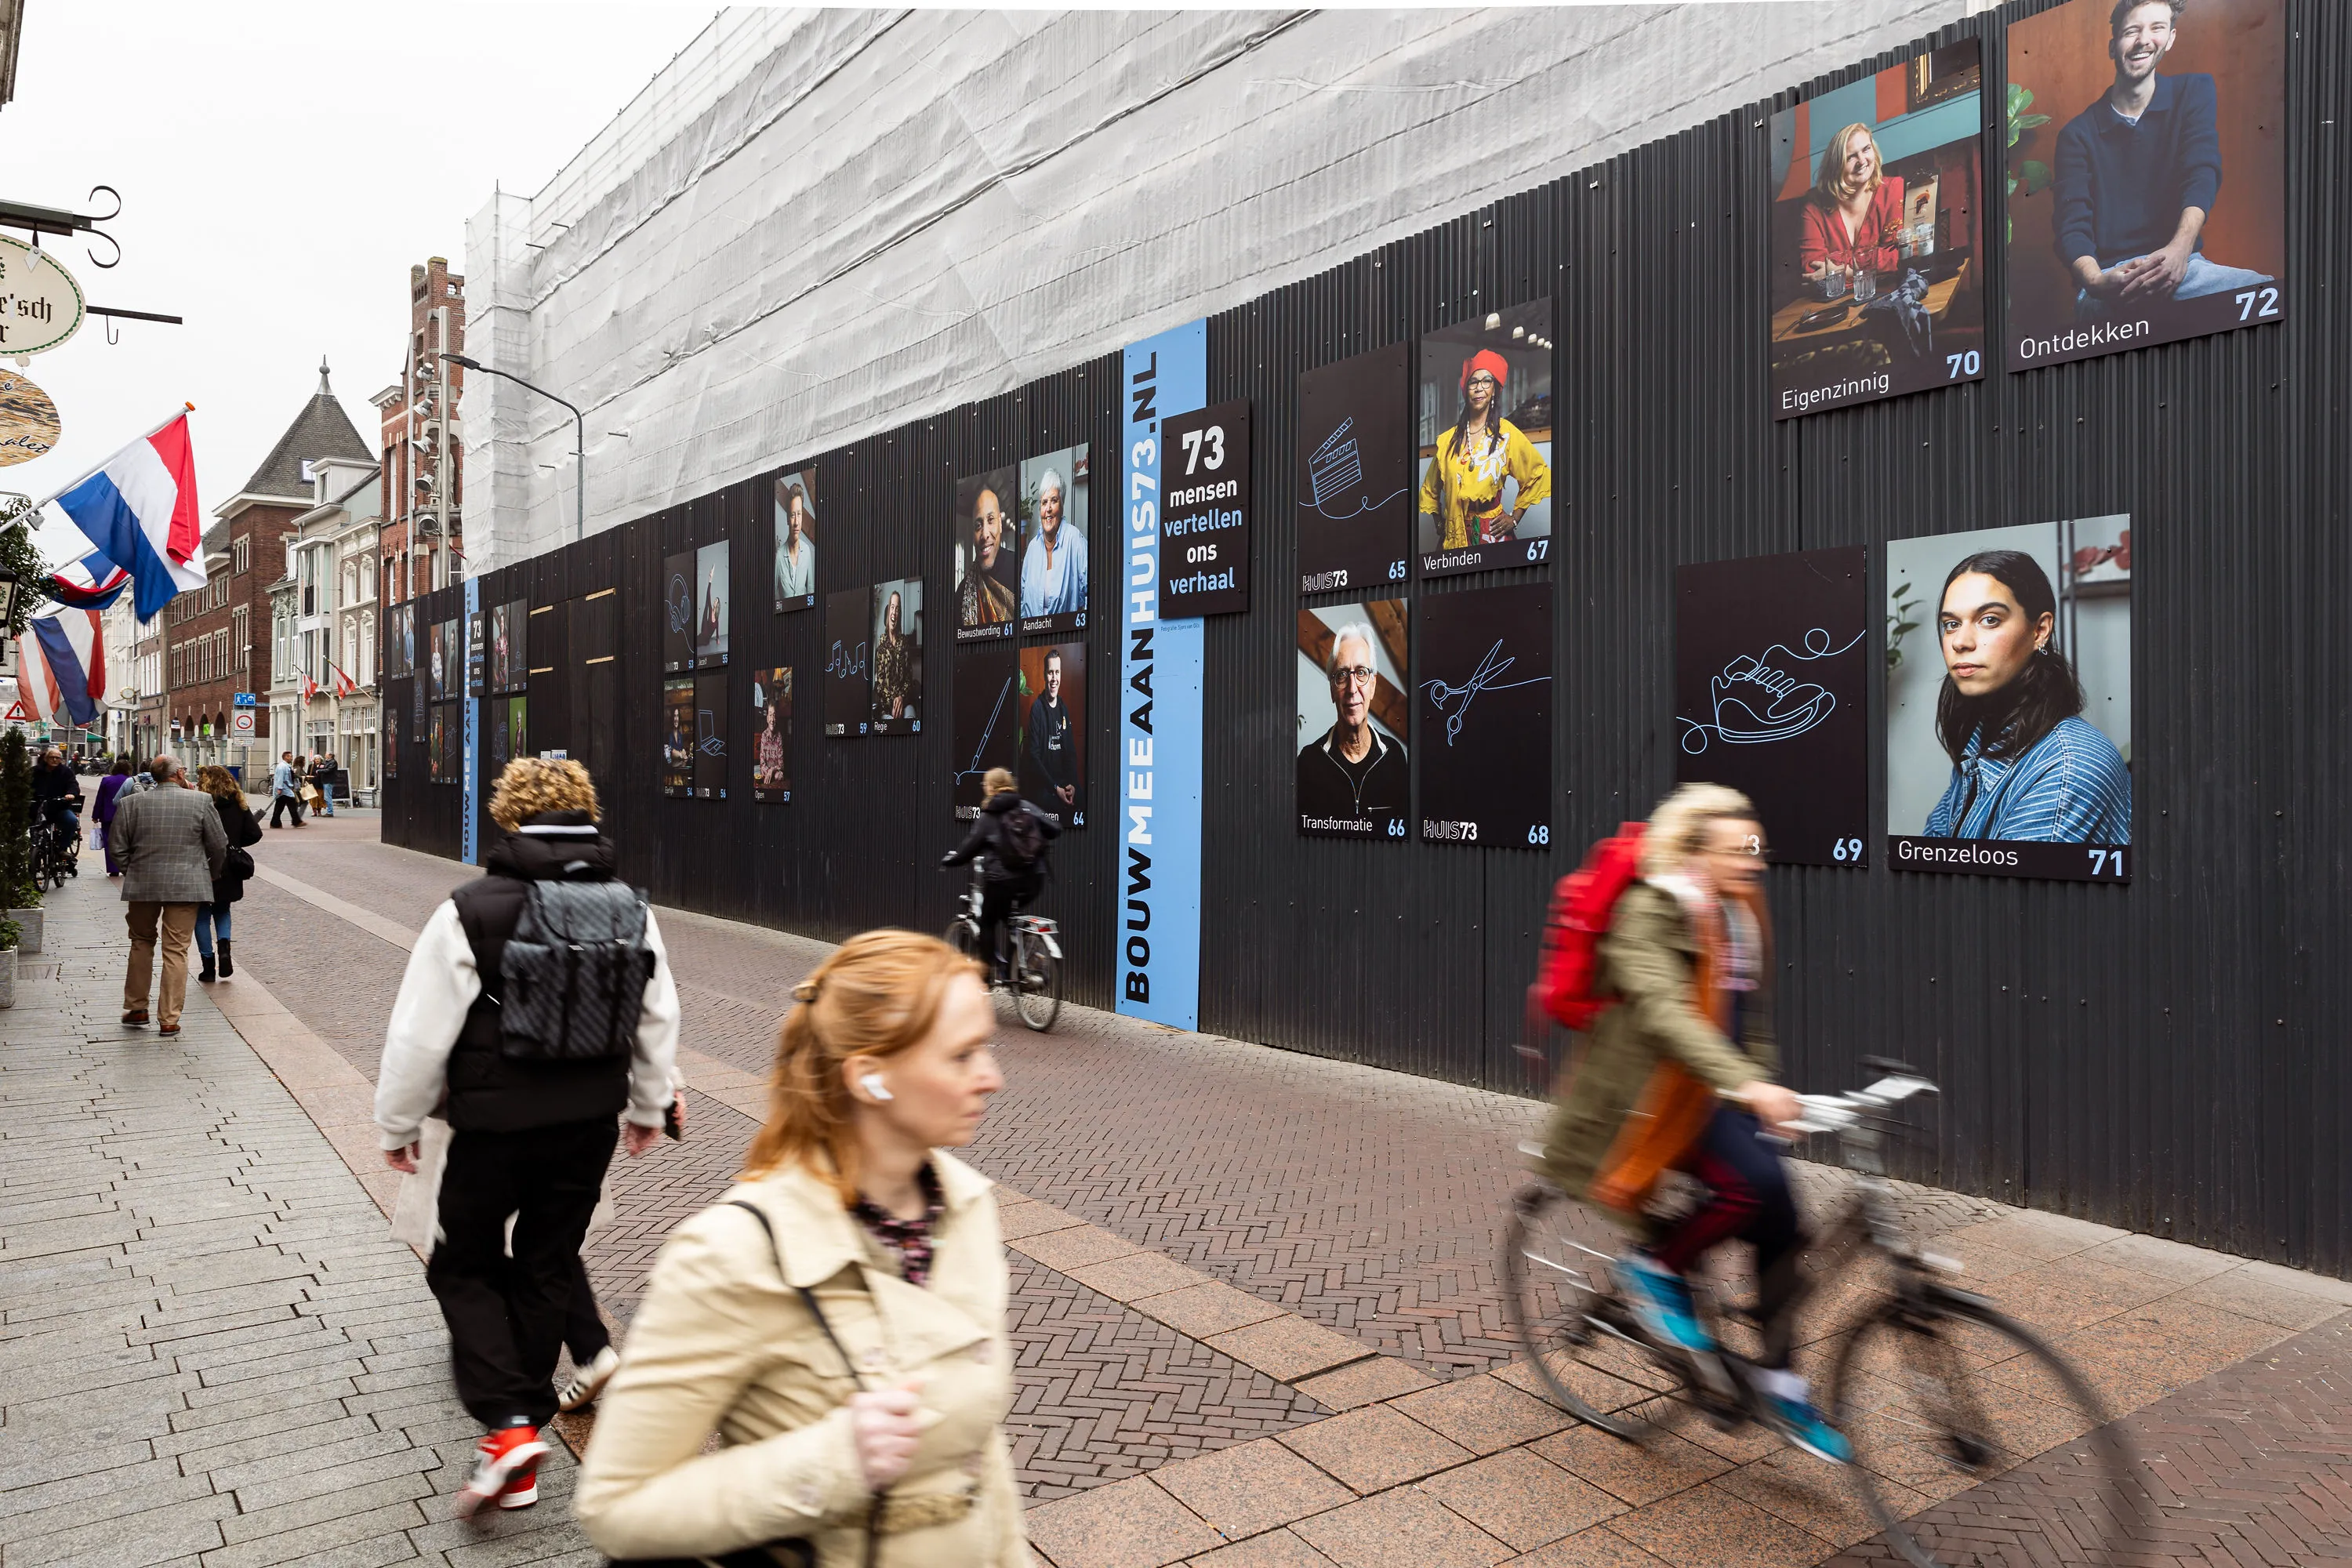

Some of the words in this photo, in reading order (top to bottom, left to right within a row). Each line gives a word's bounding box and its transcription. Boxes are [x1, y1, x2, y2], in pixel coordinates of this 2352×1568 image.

[2020, 320, 2149, 358] Ontdekken
[2235, 287, 2278, 321] 72
[1782, 371, 1889, 410] Eigenzinnig
[1947, 350, 1980, 379] 70
[1182, 426, 1225, 475] 73
[1170, 479, 1237, 507] mensen
[1164, 508, 1242, 537] vertellen
[1186, 543, 1218, 563] ons
[1424, 551, 1481, 571] Verbinden
[1526, 540, 1548, 561] 67
[1170, 567, 1235, 594] verhaal
[1302, 570, 1348, 592] HUIS73
[1388, 561, 1406, 579] 65
[807, 595, 815, 606] 58
[473, 619, 481, 639] 73
[957, 626, 1000, 639] Bewustwording
[1004, 622, 1013, 636] 61
[1023, 619, 1052, 630] Aandacht
[1076, 612, 1086, 627] 63
[859, 723, 867, 734] 59
[874, 721, 887, 733] Regie
[912, 720, 920, 731] 60
[754, 789, 765, 800] Open
[783, 791, 790, 802] 57
[955, 805, 981, 819] HUIS73
[1073, 811, 1084, 826] 64
[1301, 815, 1373, 832] Transformatie
[1388, 818, 1405, 837] 66
[1424, 819, 1478, 840] HUIS73
[1528, 825, 1549, 844] 68
[1832, 838, 1863, 862] 69
[1898, 840, 2019, 866] Grenzeloos
[2089, 850, 2122, 877] 71
